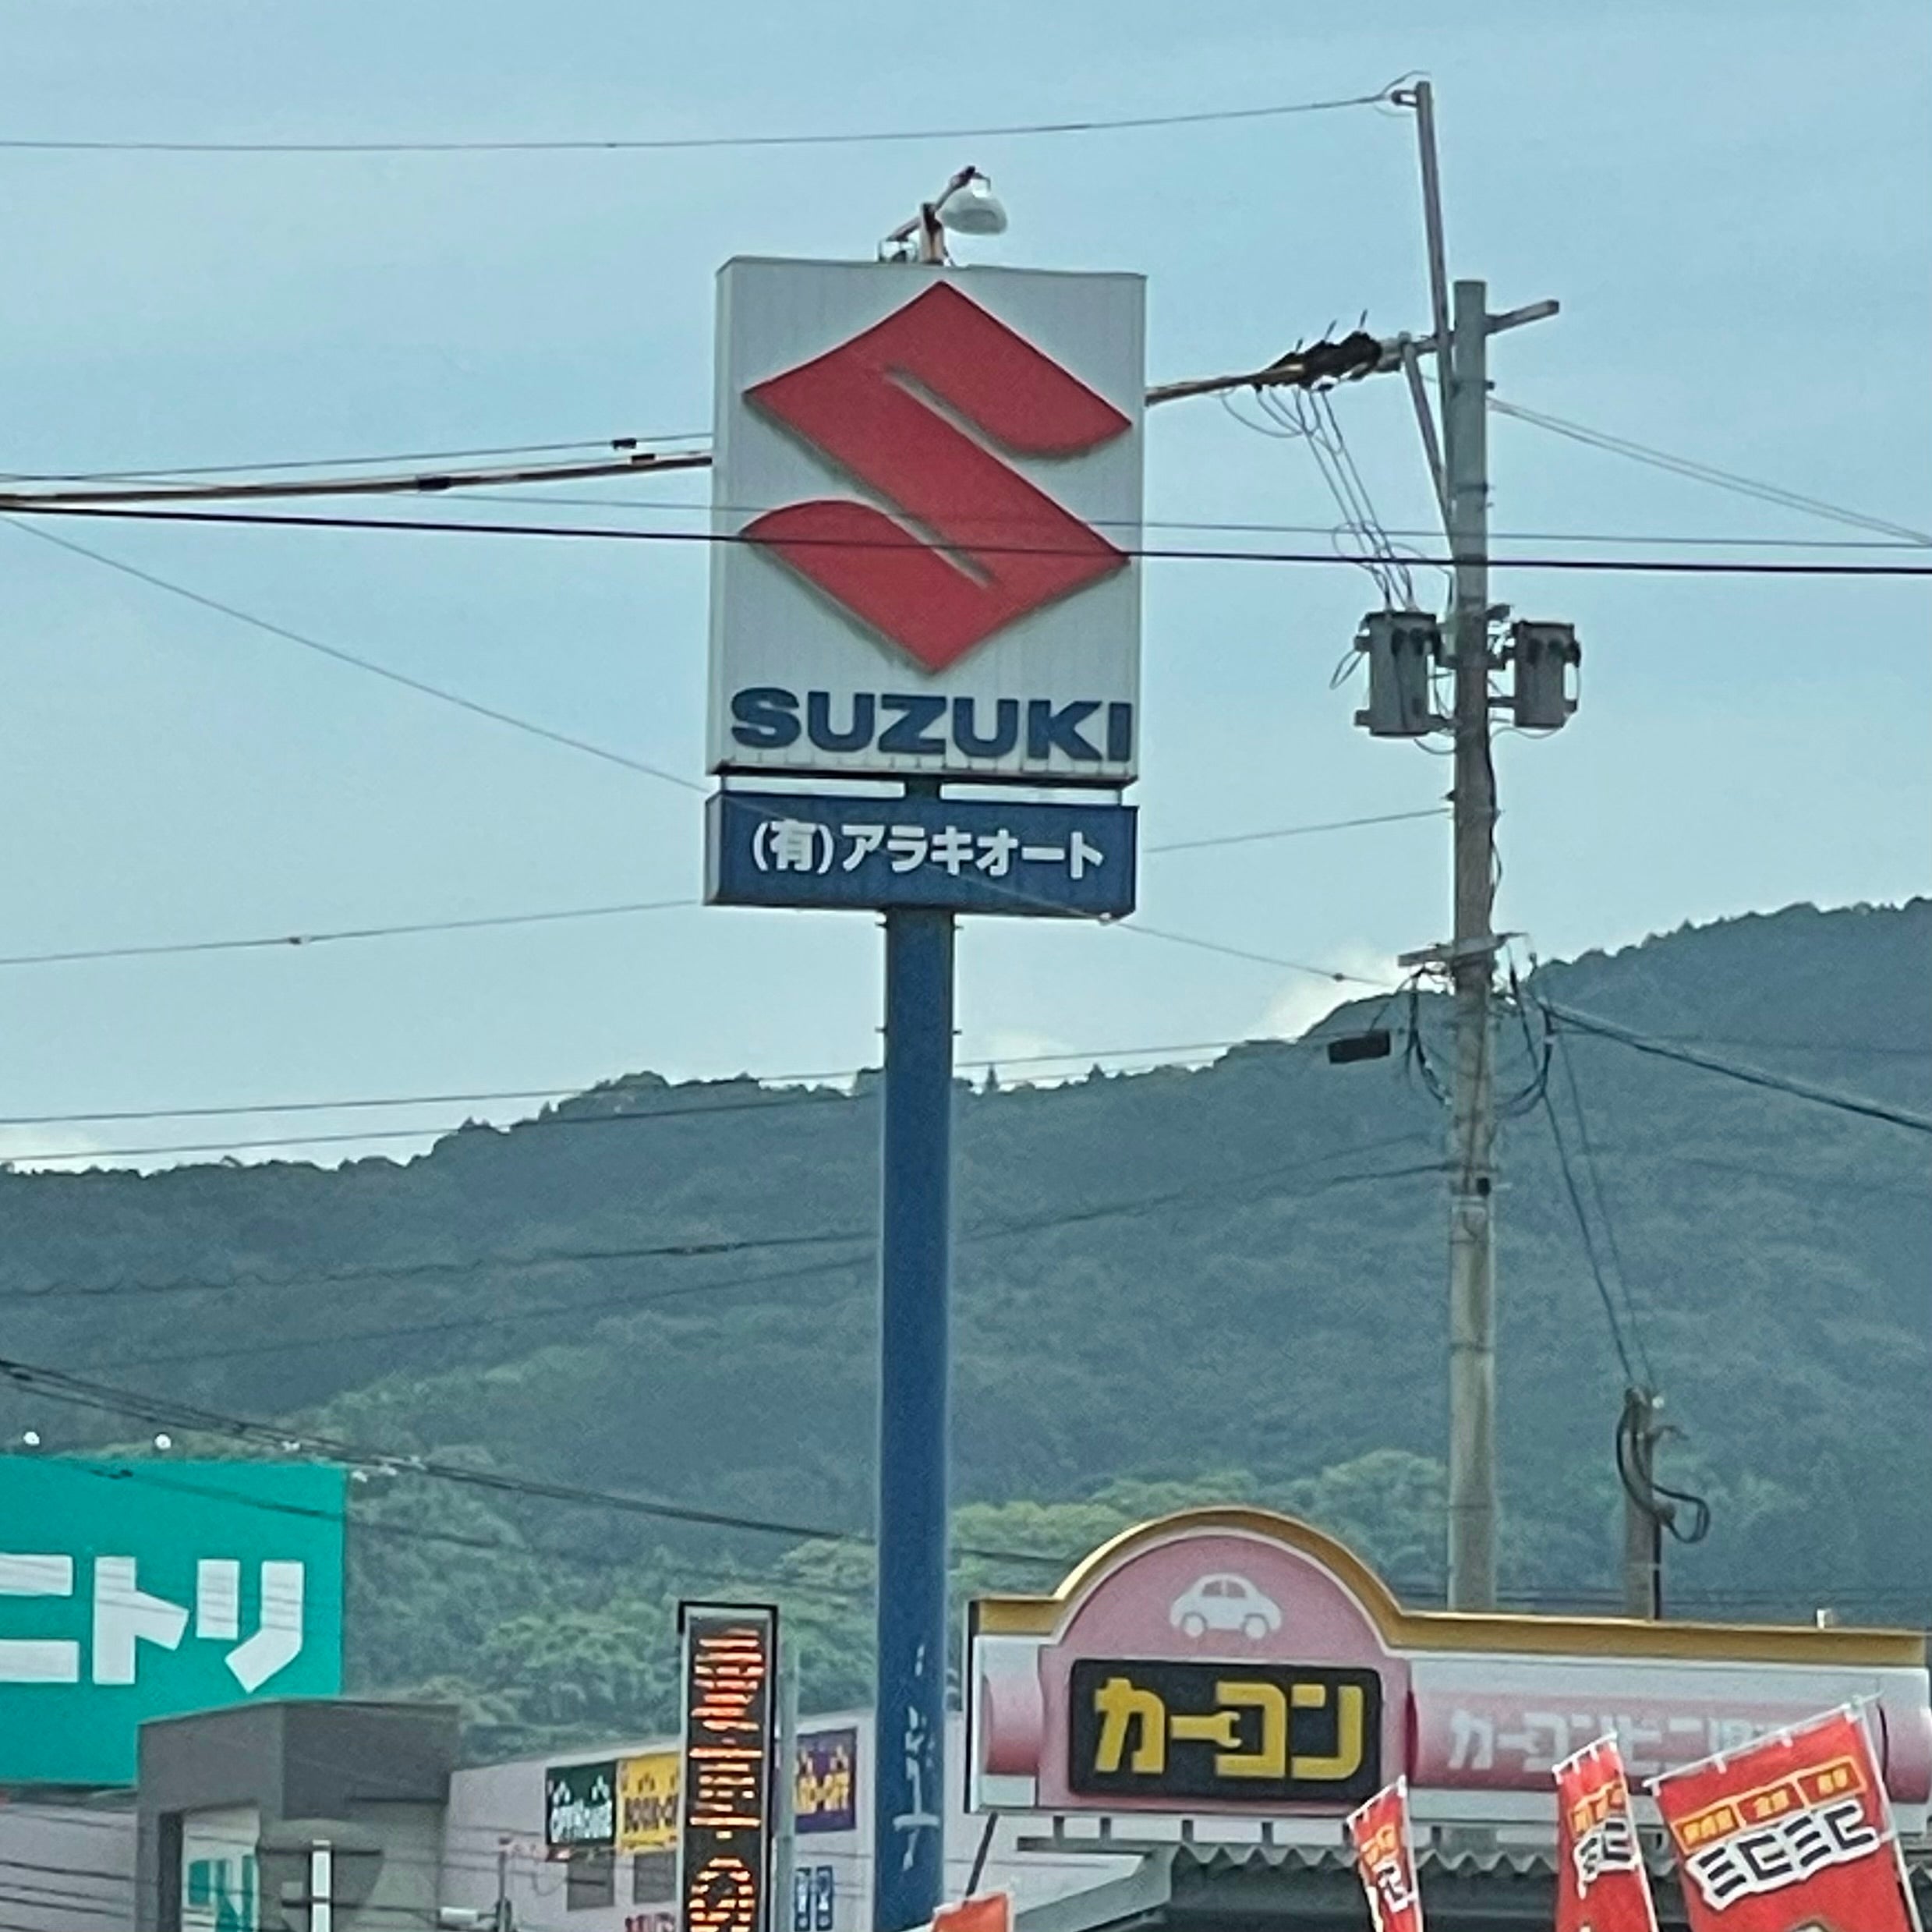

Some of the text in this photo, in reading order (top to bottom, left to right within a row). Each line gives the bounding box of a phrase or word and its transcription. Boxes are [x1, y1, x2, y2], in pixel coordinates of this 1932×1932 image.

[730, 687, 1133, 763] SUZUKI
[752, 818, 1105, 880] (有)アラキオート
[0, 1553, 305, 1693] ニトリ
[1094, 1676, 1364, 1781] カーコン
